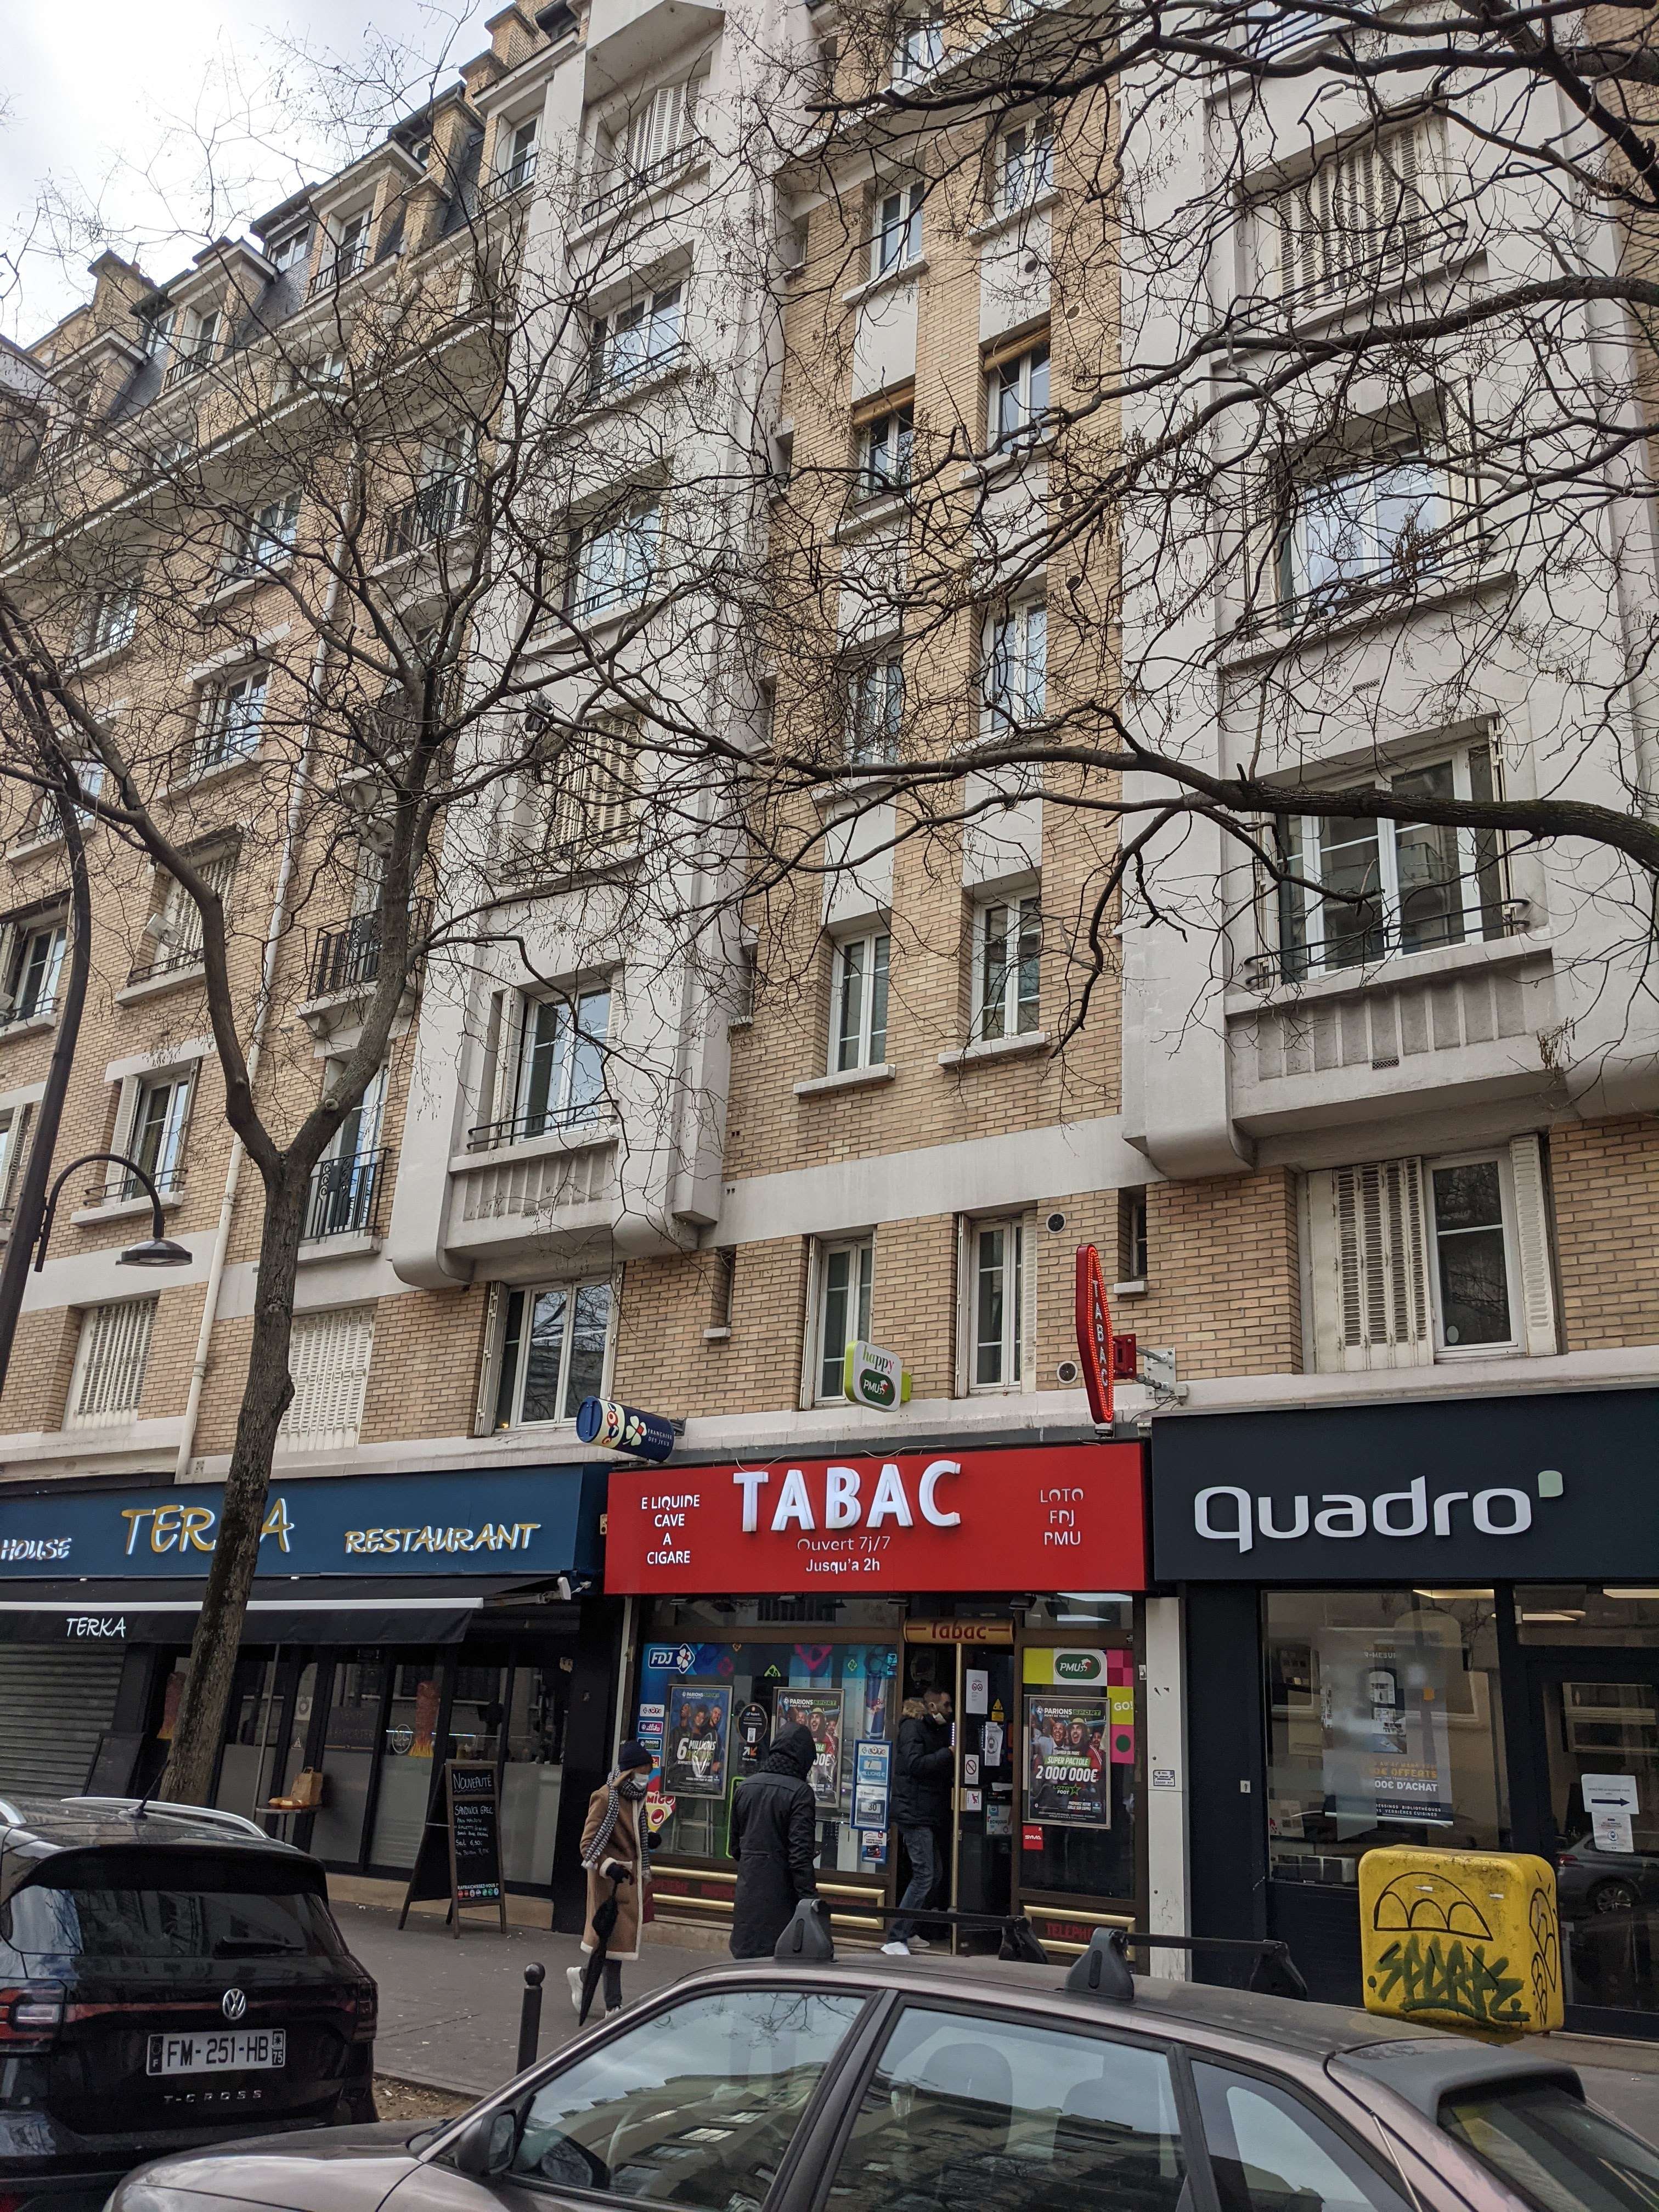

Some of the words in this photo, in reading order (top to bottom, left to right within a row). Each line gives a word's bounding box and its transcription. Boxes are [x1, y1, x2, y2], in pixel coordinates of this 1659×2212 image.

[1092, 1279, 1109, 1387] TABAC
[862, 1344, 894, 1374] happy
[864, 1379, 879, 1394] PMU
[648, 1435, 657, 1443] DES
[658, 1437, 670, 1447] JEUX
[641, 1497, 648, 1510] E
[651, 1494, 700, 1511] LIQUIDE
[733, 1460, 961, 1532] TABAC
[1040, 1487, 1084, 1503] LOTO
[654, 1513, 685, 1528] CAVE
[1049, 1509, 1075, 1527] FDJ
[121, 1498, 294, 1555] TERA
[345, 1523, 541, 1554] RESTAURANT
[662, 1532, 672, 1546] A
[797, 1537, 854, 1552] Ouvert
[859, 1536, 891, 1553] 7j/7
[1043, 1530, 1081, 1546] PMU
[1, 1537, 72, 1561] HOUSE
[646, 1550, 691, 1565] CIGARE
[863, 1558, 880, 1572] 2h
[66, 1616, 126, 1638] TERKA
[931, 1620, 986, 1640] Tabac
[651, 1652, 673, 1664] FDJ
[1059, 1662, 1082, 1672] PMU
[1114, 1701, 1133, 1712] GO!
[676, 1737, 689, 1760] 6
[867, 1760, 872, 1768] 7
[1047, 1756, 1065, 1764] SUPER
[1065, 1757, 1089, 1766] PACTOLE
[1035, 1765, 1044, 1779] 2
[1045, 1765, 1068, 1781] 000
[1068, 1767, 1099, 1783] 000€
[867, 1803, 877, 1811] 30
[152, 2058, 159, 2068] F
[272, 2051, 283, 2064] 75
[163, 2089, 262, 2104] T-CROSS
